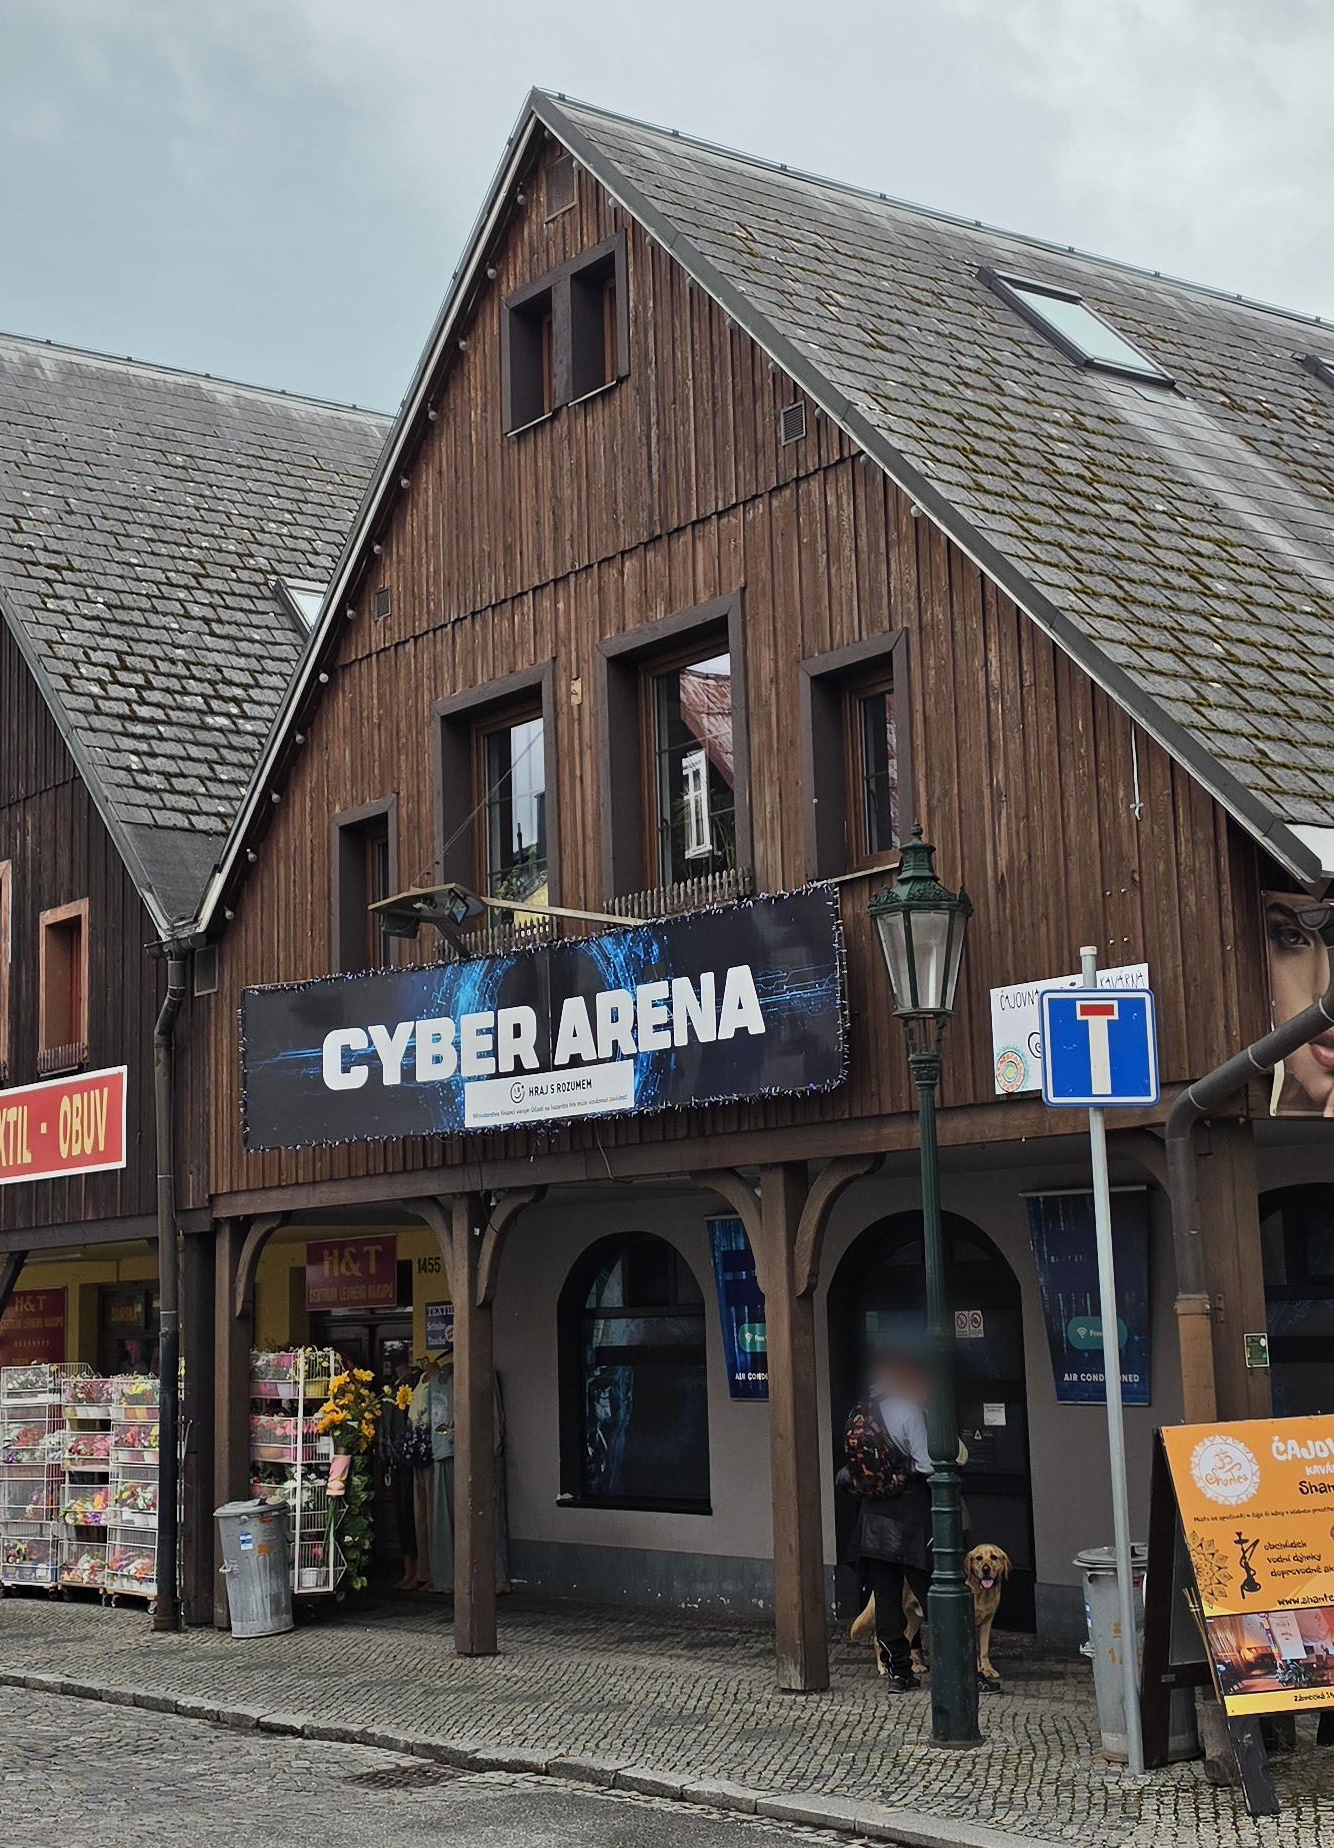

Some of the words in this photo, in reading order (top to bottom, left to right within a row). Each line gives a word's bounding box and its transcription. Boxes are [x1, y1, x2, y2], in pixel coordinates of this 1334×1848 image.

[322, 1006, 538, 1091] CYBER
[554, 965, 765, 1065] ARENA
[529, 1085, 548, 1097] HRAJ
[550, 1083, 555, 1094] S
[557, 1078, 592, 1093] ROZUMEM
[59, 1087, 108, 1159] OBUV
[323, 1245, 382, 1277] H&T
[417, 1257, 441, 1274] 1455
[735, 1372, 746, 1381] AIR
[748, 1371, 768, 1381] COND
[1063, 1373, 1078, 1382] AIR
[1267, 1554, 1291, 1564] vodní
[1270, 1565, 1322, 1579] doprovodné
